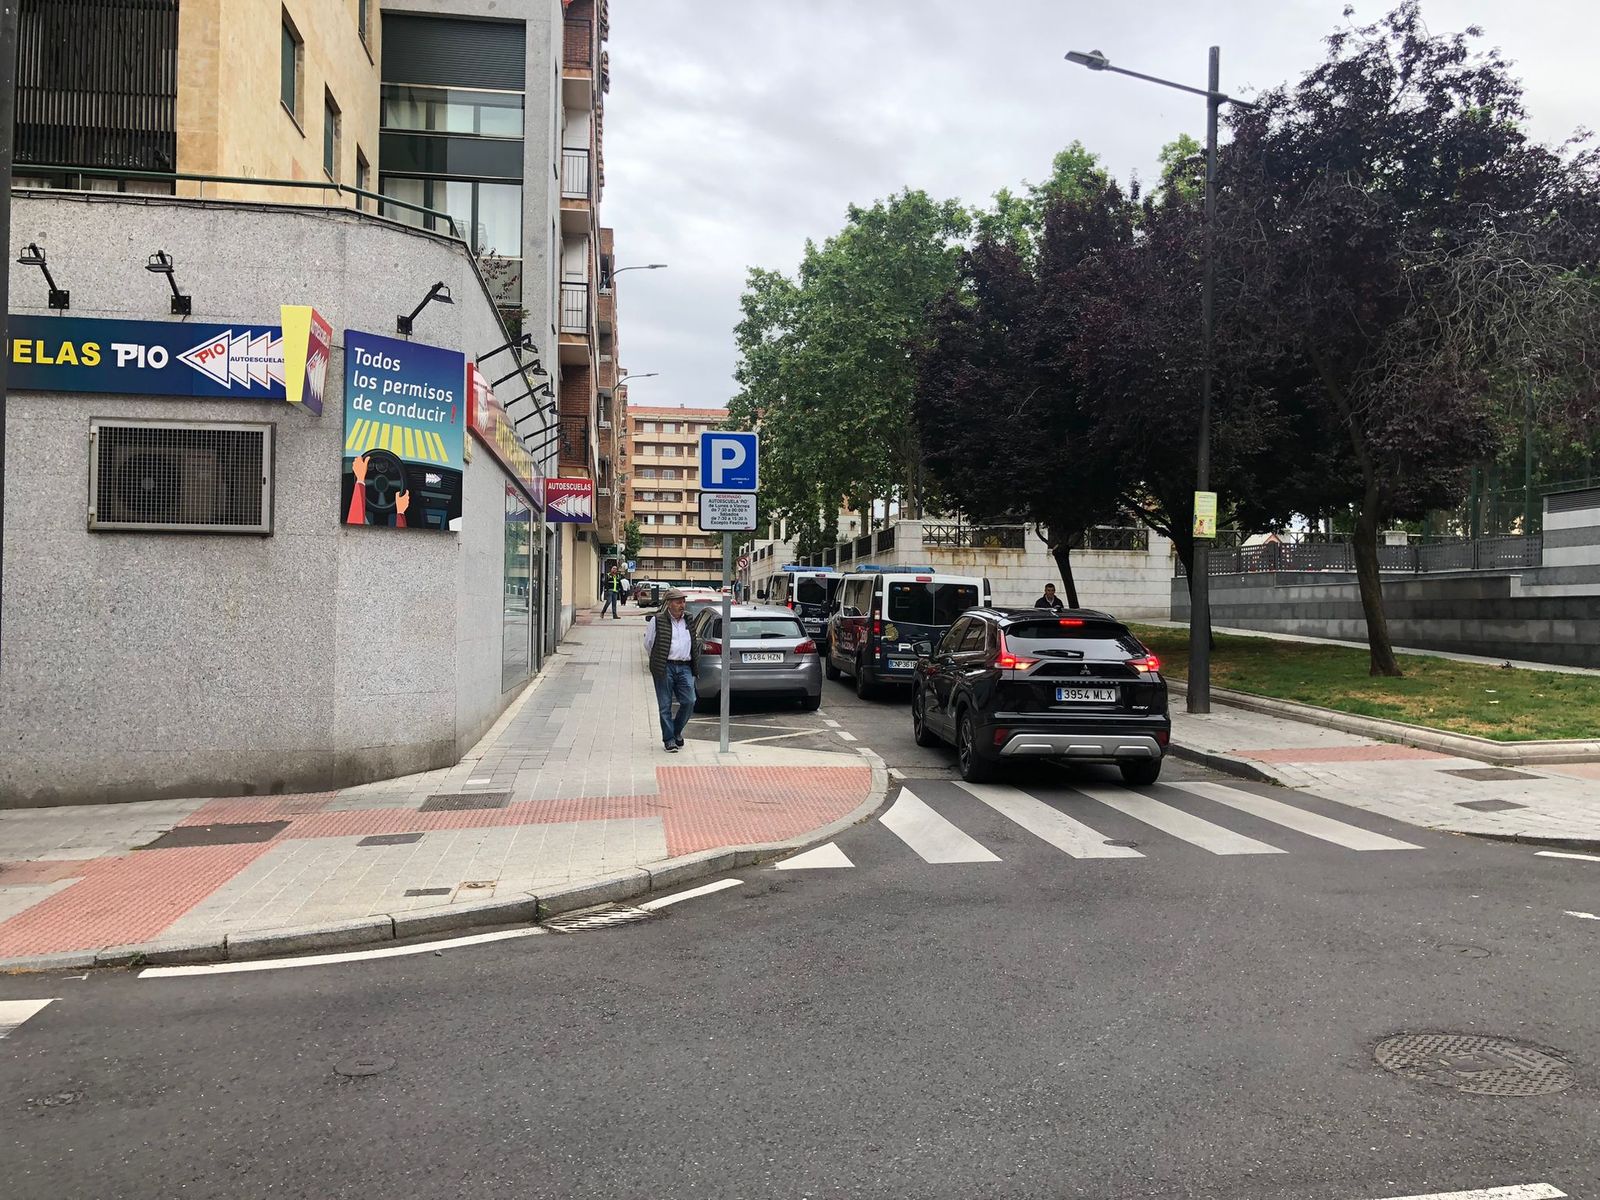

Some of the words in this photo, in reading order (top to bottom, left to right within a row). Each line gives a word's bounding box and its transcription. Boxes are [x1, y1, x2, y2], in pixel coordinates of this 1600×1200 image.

[7, 339, 101, 366] ELAS
[111, 343, 169, 369] PIO
[195, 343, 225, 364] PIO
[355, 347, 401, 372] Todos
[353, 370, 378, 390] los
[382, 379, 453, 403] permisos
[353, 394, 373, 412] de
[378, 401, 446, 423] conducir
[711, 439, 746, 484] P
[547, 482, 592, 491] AUTOESCUELAS
[748, 653, 766, 661] 3484
[767, 653, 781, 661] HZN
[1064, 689, 1090, 700] 3954
[1093, 690, 1113, 700] MLX
